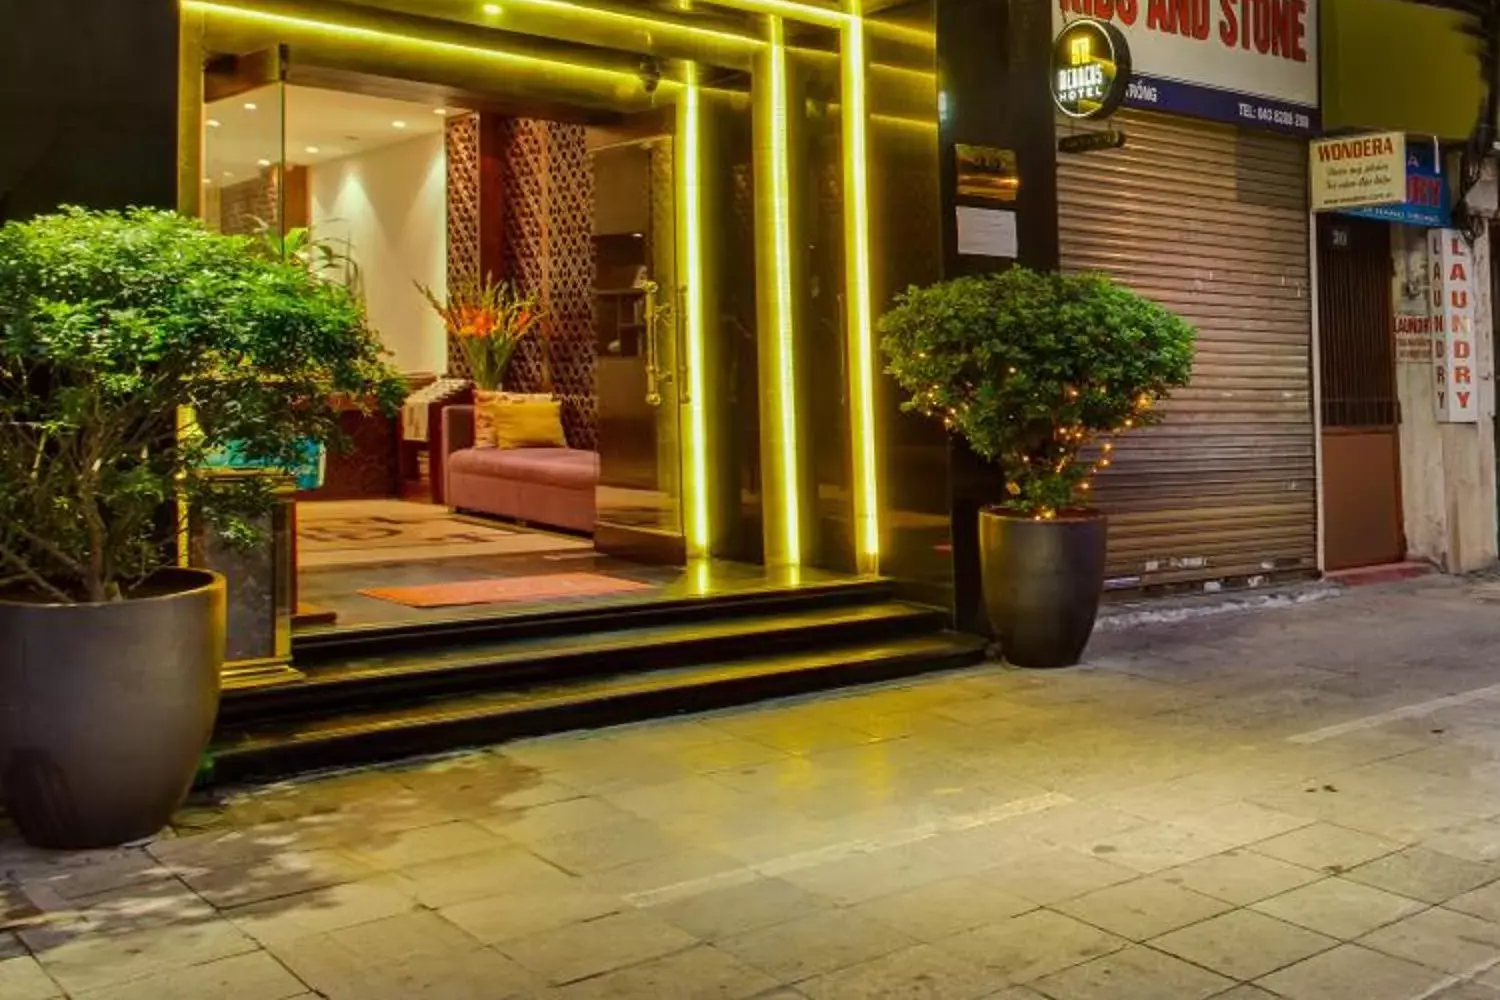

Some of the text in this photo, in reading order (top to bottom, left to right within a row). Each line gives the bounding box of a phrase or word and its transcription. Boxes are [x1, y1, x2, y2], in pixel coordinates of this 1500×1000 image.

[1318, 137, 1394, 162] WONDERA
[1433, 238, 1445, 409] LAUNDRY
[1449, 238, 1471, 408] LAUNDRY
